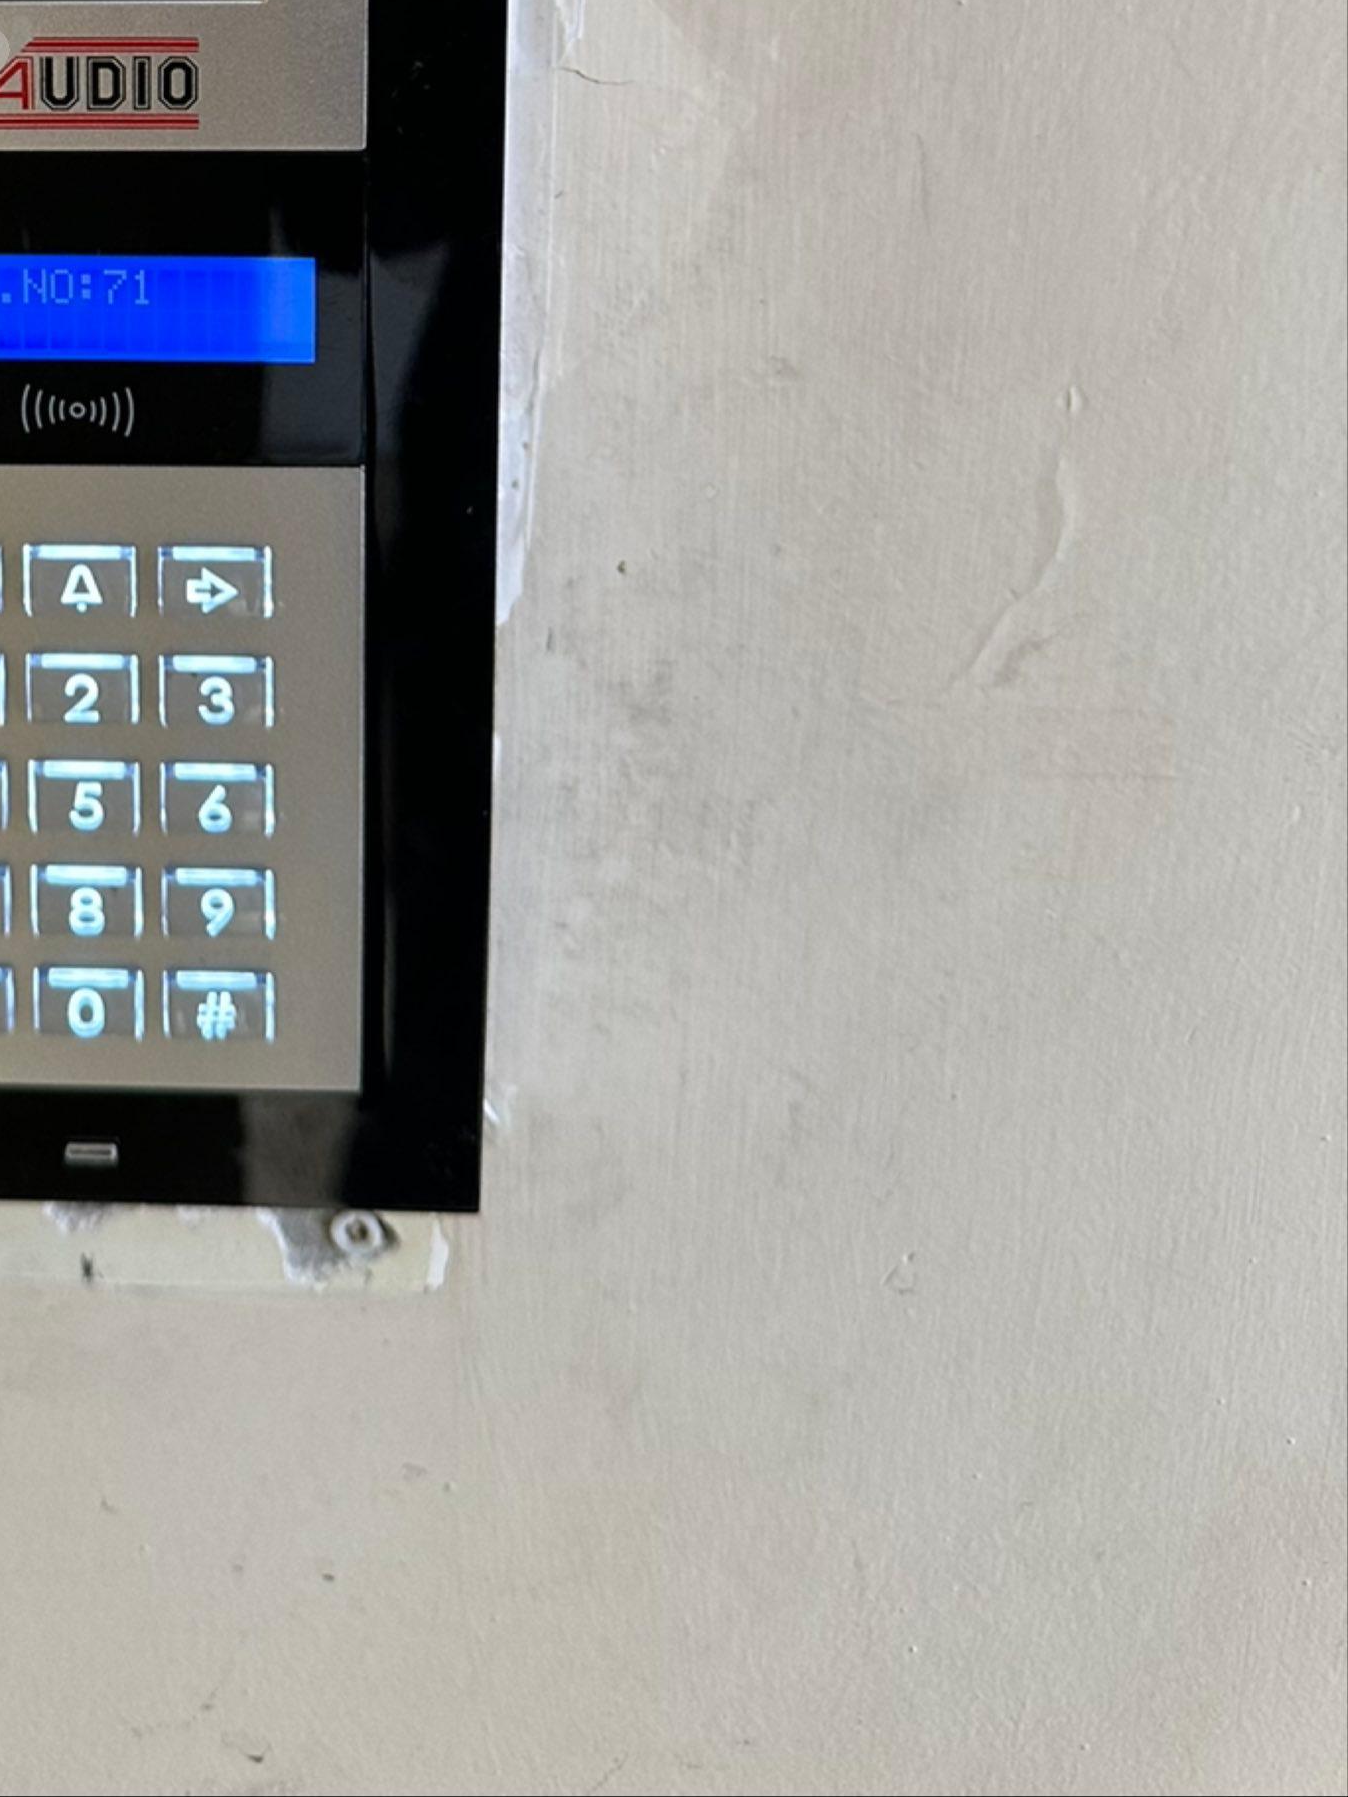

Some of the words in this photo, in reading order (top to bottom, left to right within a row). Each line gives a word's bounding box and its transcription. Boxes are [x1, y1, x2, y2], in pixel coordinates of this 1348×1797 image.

[64, 673, 100, 723] 2
[198, 676, 235, 725] 3
[69, 781, 104, 831] 5
[198, 784, 232, 833] 6
[68, 887, 105, 936] 8
[200, 889, 235, 937] 9
